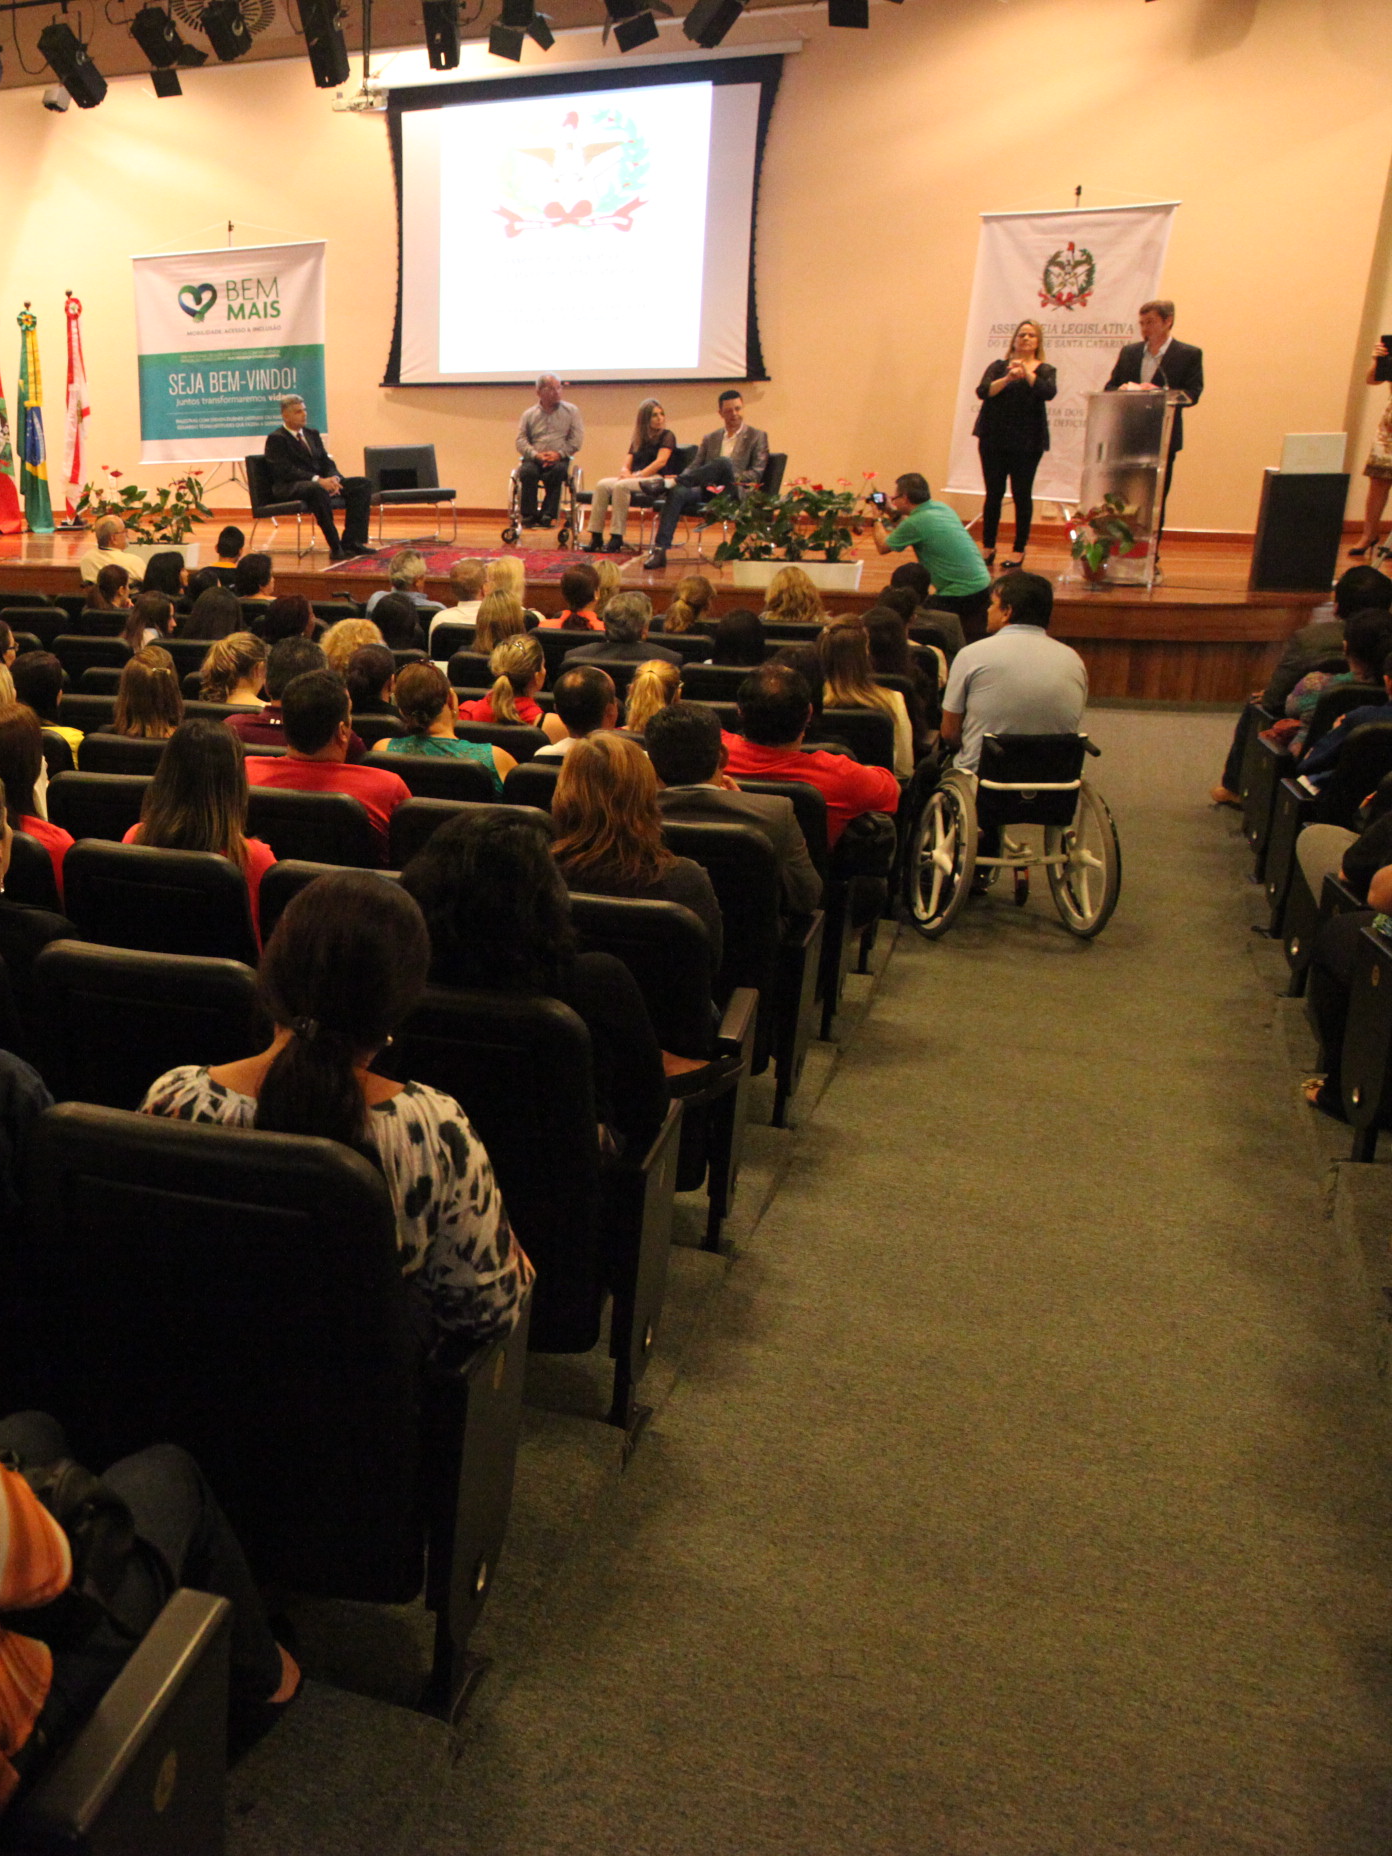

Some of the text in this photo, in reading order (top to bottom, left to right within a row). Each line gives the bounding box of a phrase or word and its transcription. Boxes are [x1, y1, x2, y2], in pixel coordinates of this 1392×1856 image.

[225, 276, 279, 301] BEM
[226, 300, 282, 321] MAIS
[1061, 322, 1134, 335] LEGISLATIVA
[1054, 339, 1083, 349] SANTA
[168, 367, 297, 395] SEJA BEM-VINDO!
[201, 394, 266, 405] transformaremos
